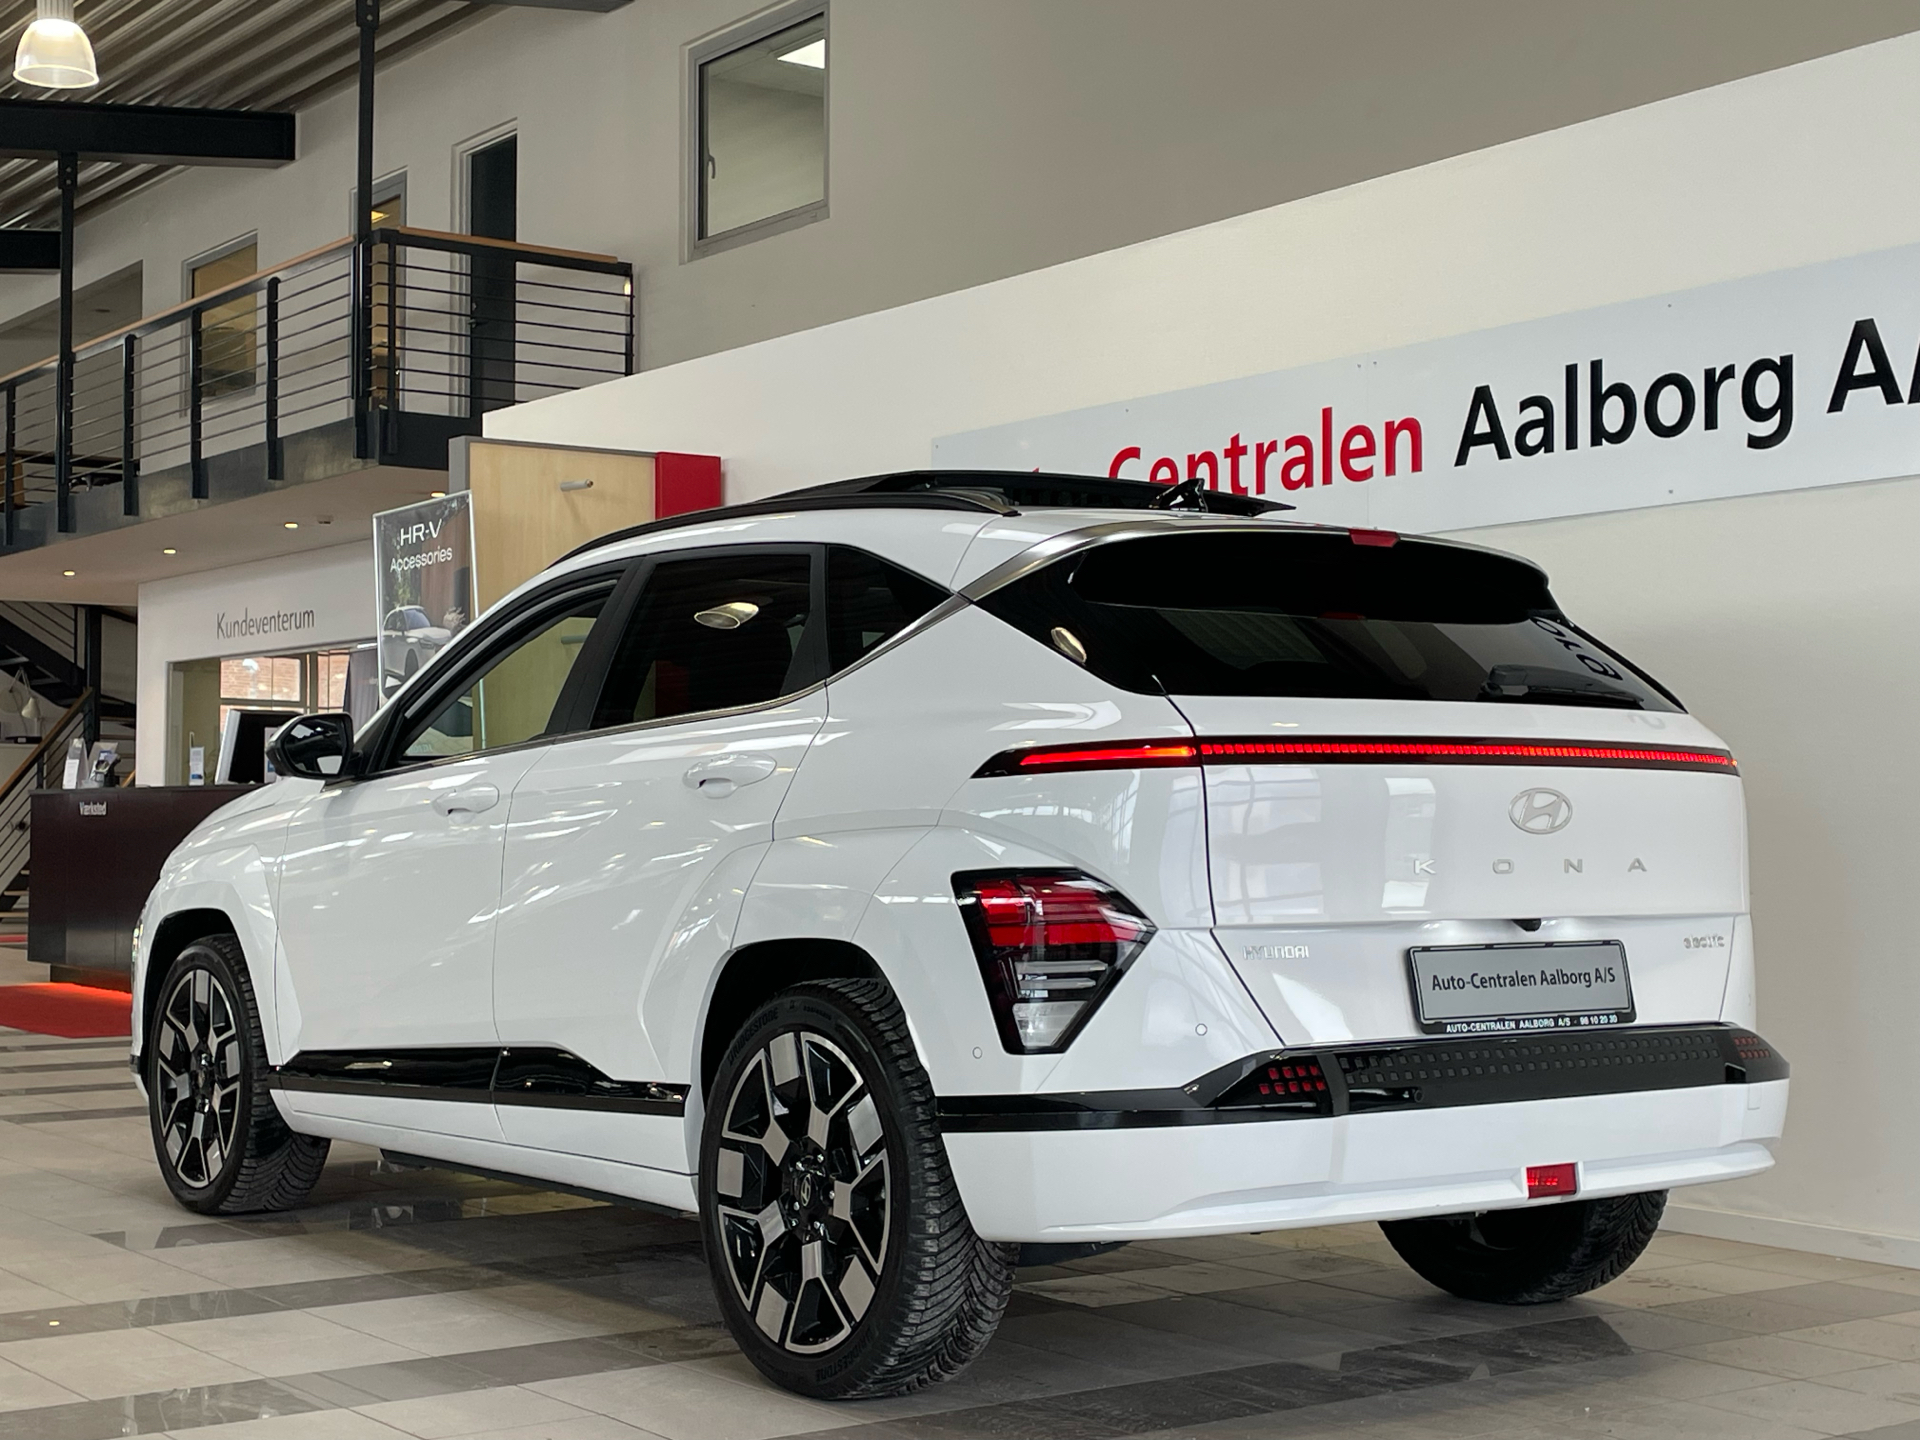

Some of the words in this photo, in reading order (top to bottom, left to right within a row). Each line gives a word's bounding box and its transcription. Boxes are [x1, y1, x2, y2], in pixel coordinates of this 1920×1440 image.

[1453, 353, 1794, 467] Aalborg
[400, 517, 443, 547] HR-V
[389, 545, 453, 573] Accessories
[216, 606, 315, 640] Kundeventerum
[1413, 857, 1648, 875] KONA
[1242, 945, 1310, 960] HYUNDAI
[1431, 969, 1537, 991] Auto-Centralen
[1540, 968, 1592, 988] Aalborg
[1594, 966, 1616, 984] A/S
[1446, 1020, 1516, 1034] AUTO-CENTRALEN
[1519, 1017, 1555, 1030] AALBORG
[1557, 1017, 1571, 1027] A/S
[1590, 1015, 1599, 1025] 10
